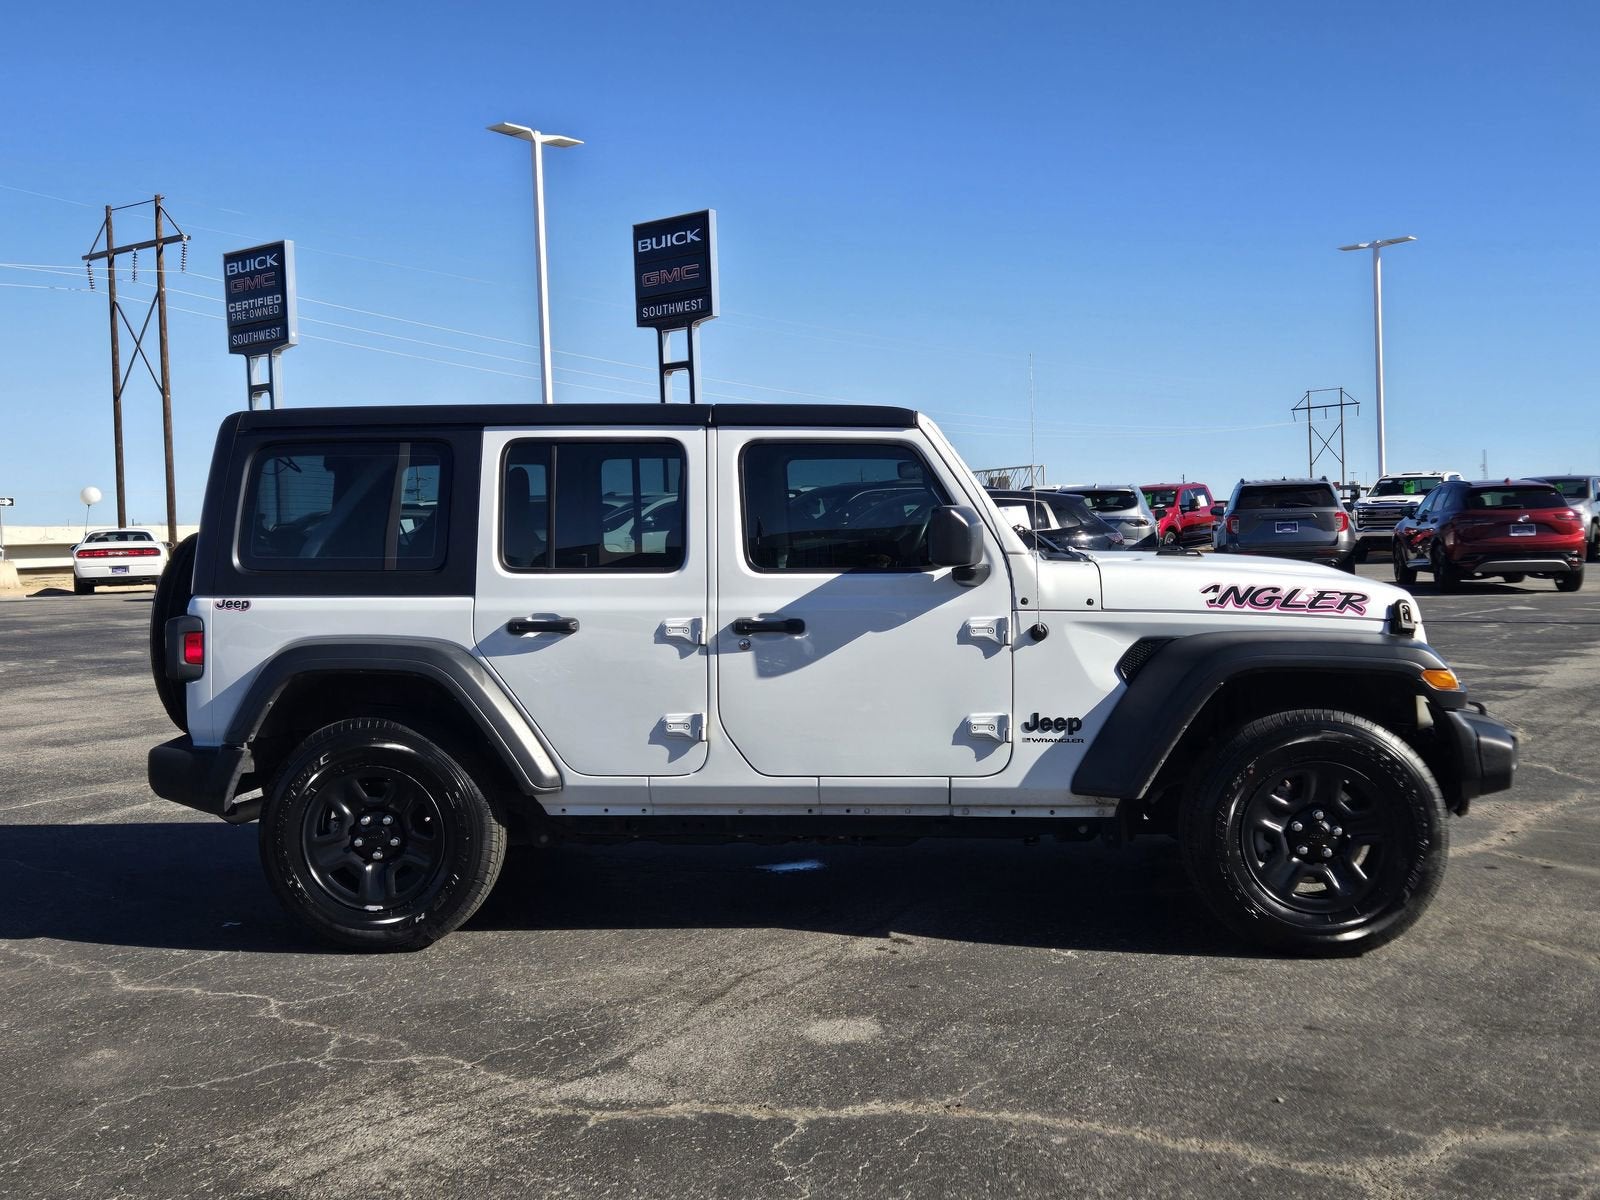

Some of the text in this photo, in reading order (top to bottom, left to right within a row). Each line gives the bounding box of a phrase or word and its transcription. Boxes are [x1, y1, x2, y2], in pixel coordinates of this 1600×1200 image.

[637, 227, 702, 253] BUICK
[226, 253, 279, 276] BUICK
[230, 271, 276, 293] GMC
[642, 263, 700, 288] GMC
[228, 294, 282, 313] CERTIFIED
[231, 305, 280, 321] PRE-OWNED
[642, 298, 703, 318] SOUTHWEST
[232, 327, 281, 345] SOUTHWEST
[215, 599, 250, 610] Jeep
[1022, 712, 1082, 735] Jeep
